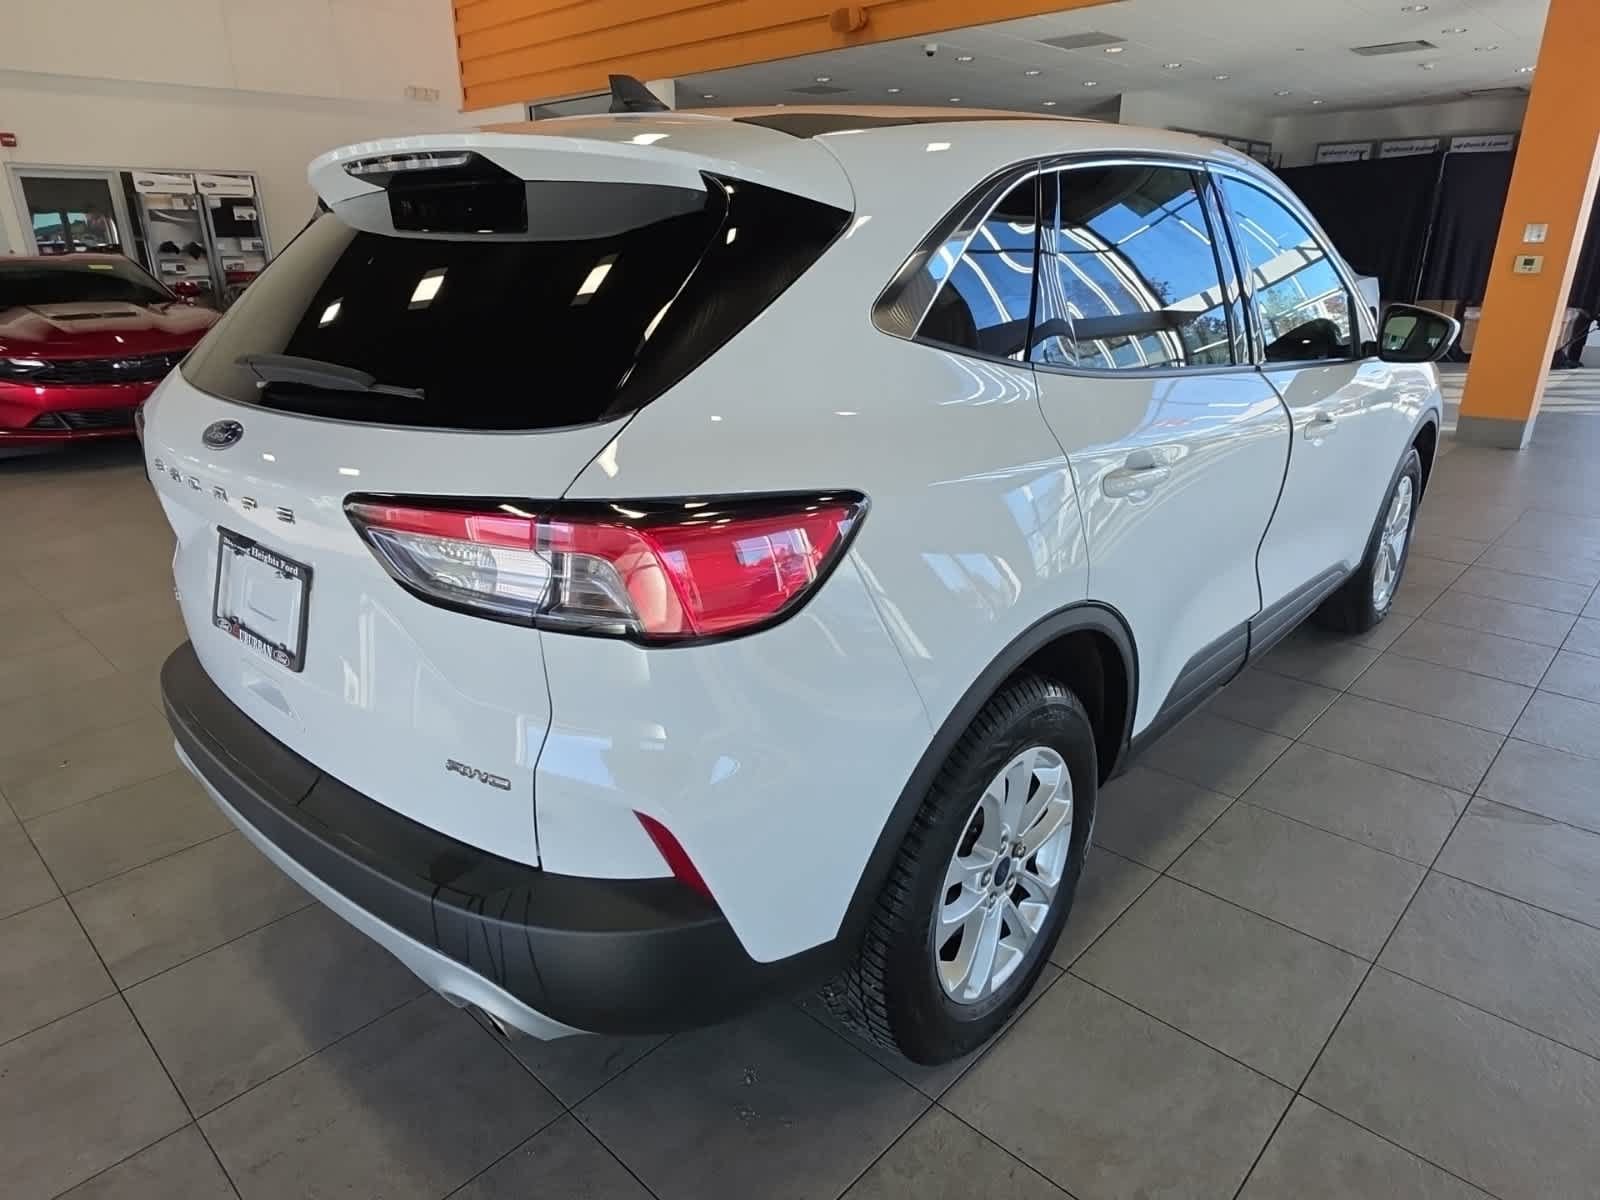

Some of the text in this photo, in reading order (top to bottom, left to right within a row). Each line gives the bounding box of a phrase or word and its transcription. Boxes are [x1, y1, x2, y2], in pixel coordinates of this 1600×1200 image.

[154, 457, 296, 525] ESCAPE
[251, 546, 280, 568] Heights
[280, 560, 298, 576] Ford
[445, 758, 511, 791] AWD
